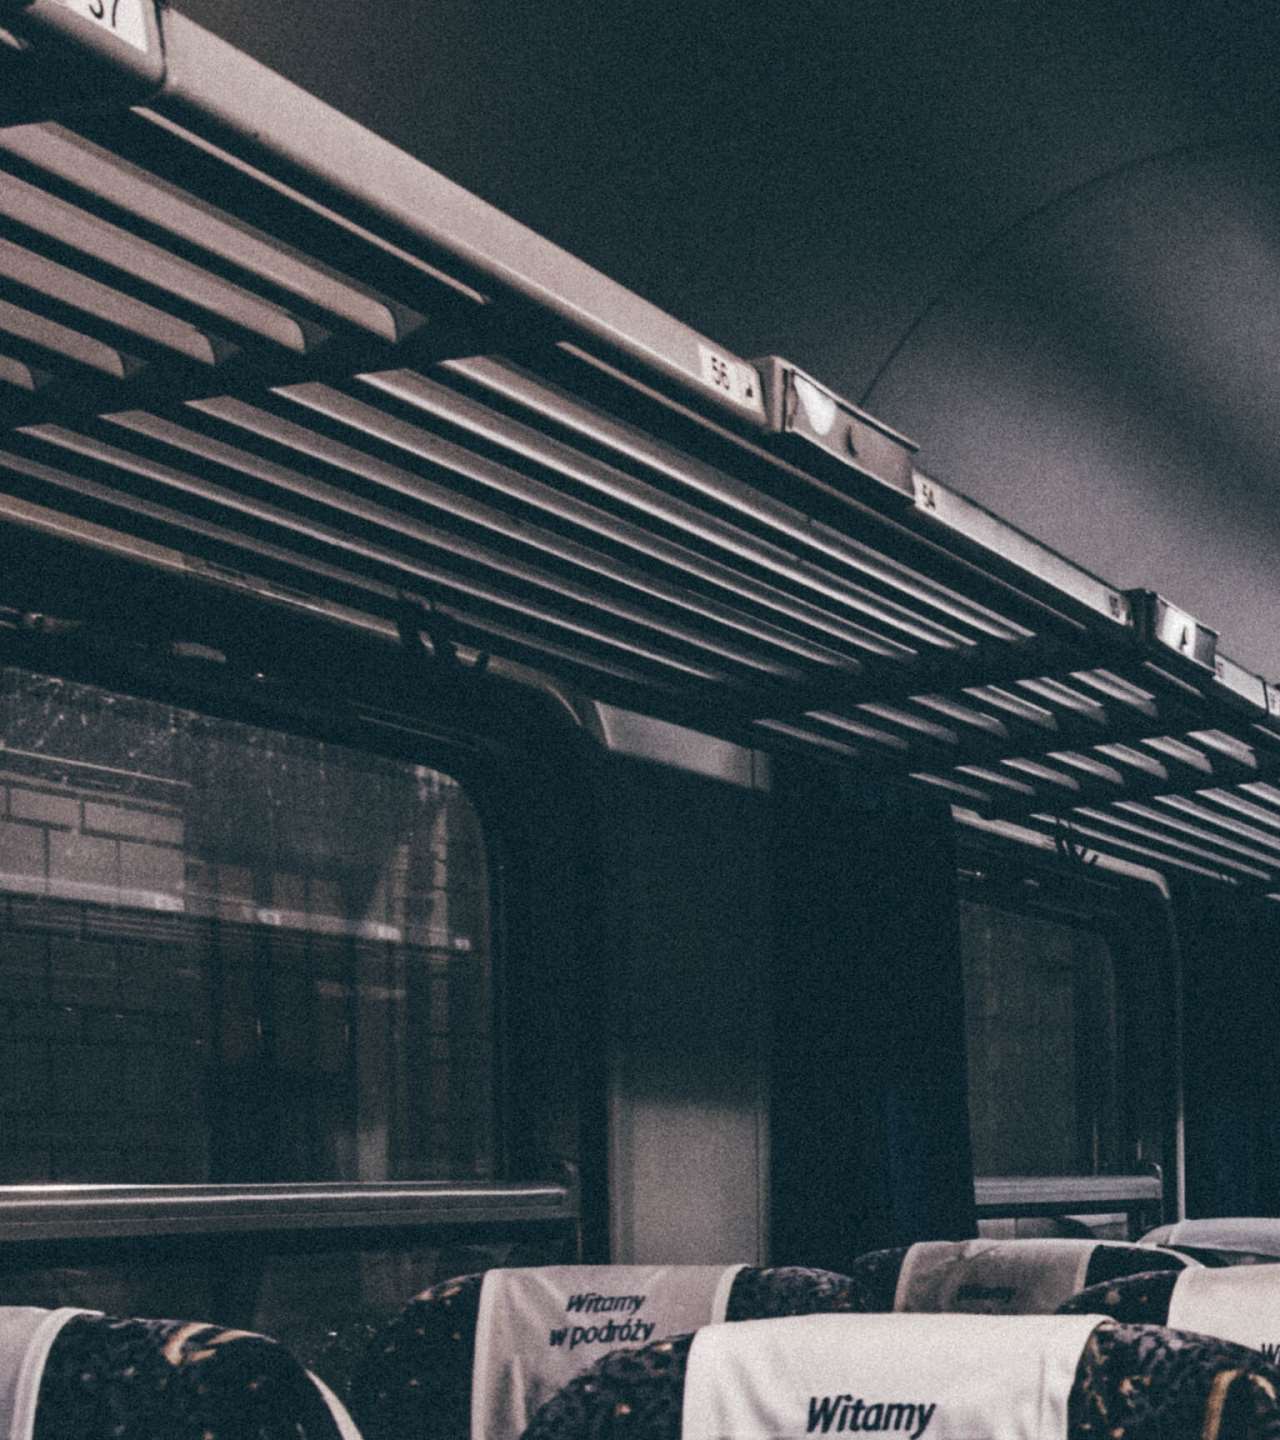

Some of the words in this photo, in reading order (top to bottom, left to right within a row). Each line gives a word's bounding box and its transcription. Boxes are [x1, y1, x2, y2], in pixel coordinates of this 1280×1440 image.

[566, 1292, 646, 1316] Witamy
[549, 1327, 571, 1347] w
[569, 1318, 656, 1350] podróży
[806, 1394, 937, 1440] Witamy
